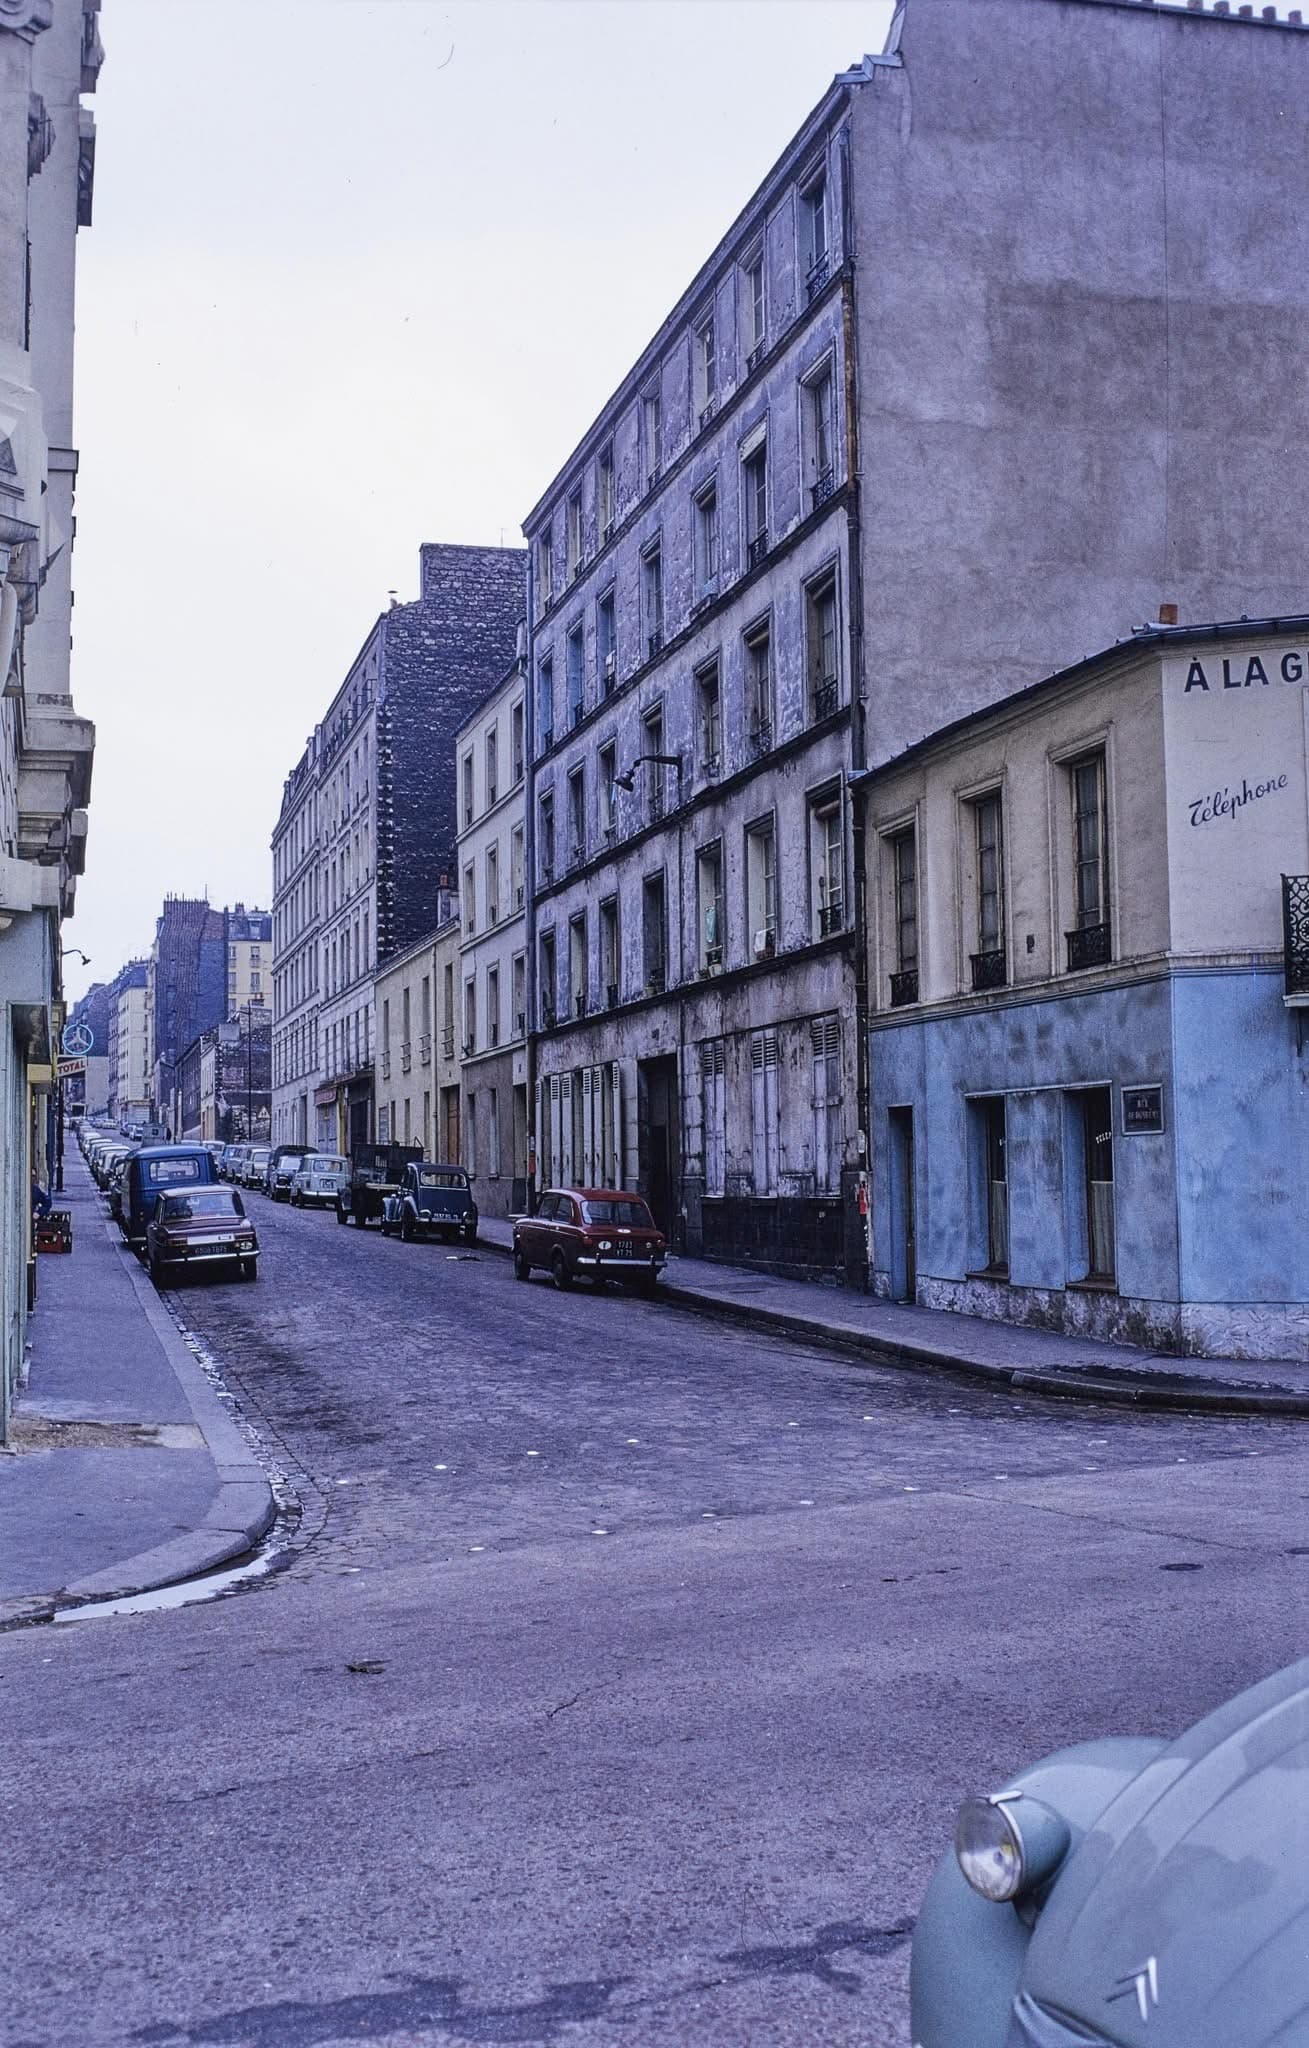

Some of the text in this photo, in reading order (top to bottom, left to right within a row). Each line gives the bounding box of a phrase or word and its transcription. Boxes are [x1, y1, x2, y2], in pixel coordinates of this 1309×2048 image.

[1184, 652, 1309, 693] À LA G
[1188, 773, 1289, 828] Téléphone
[57, 1060, 86, 1074] TOTAL
